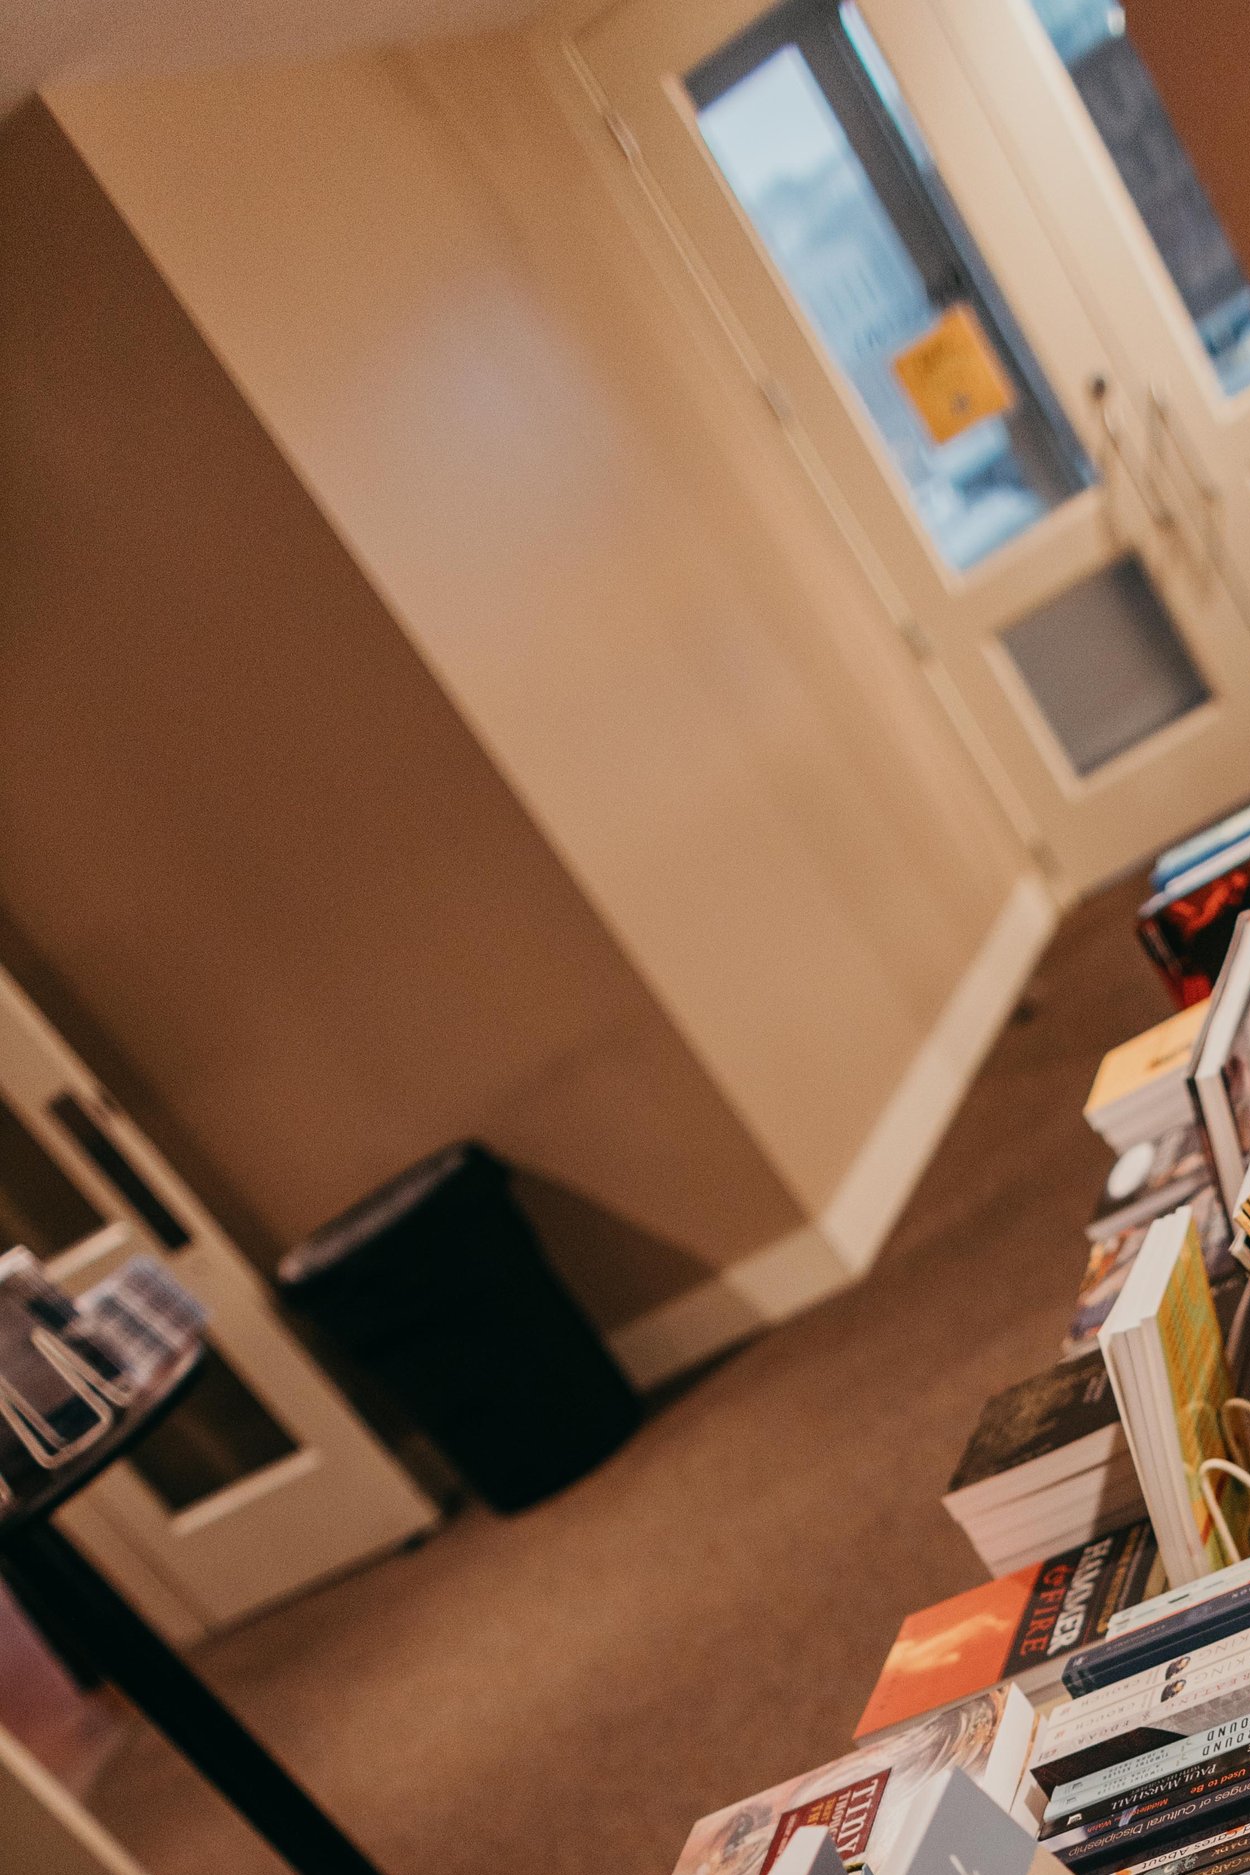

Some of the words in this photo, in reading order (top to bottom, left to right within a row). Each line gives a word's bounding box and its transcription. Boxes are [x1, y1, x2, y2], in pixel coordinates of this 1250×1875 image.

[1180, 1763, 1217, 1783] PAUL
[1205, 1777, 1219, 1789] to
[1218, 1767, 1247, 1784] Used
[1109, 1776, 1182, 1810] MARSHALL
[1188, 1782, 1205, 1796] Be
[1196, 1796, 1212, 1809] of
[836, 1778, 880, 1853] TINY
[1147, 1802, 1197, 1830] Cultural
[1066, 1820, 1148, 1859] Discipleship
[1192, 1829, 1234, 1851] Cares
[1140, 1846, 1190, 1871] About
